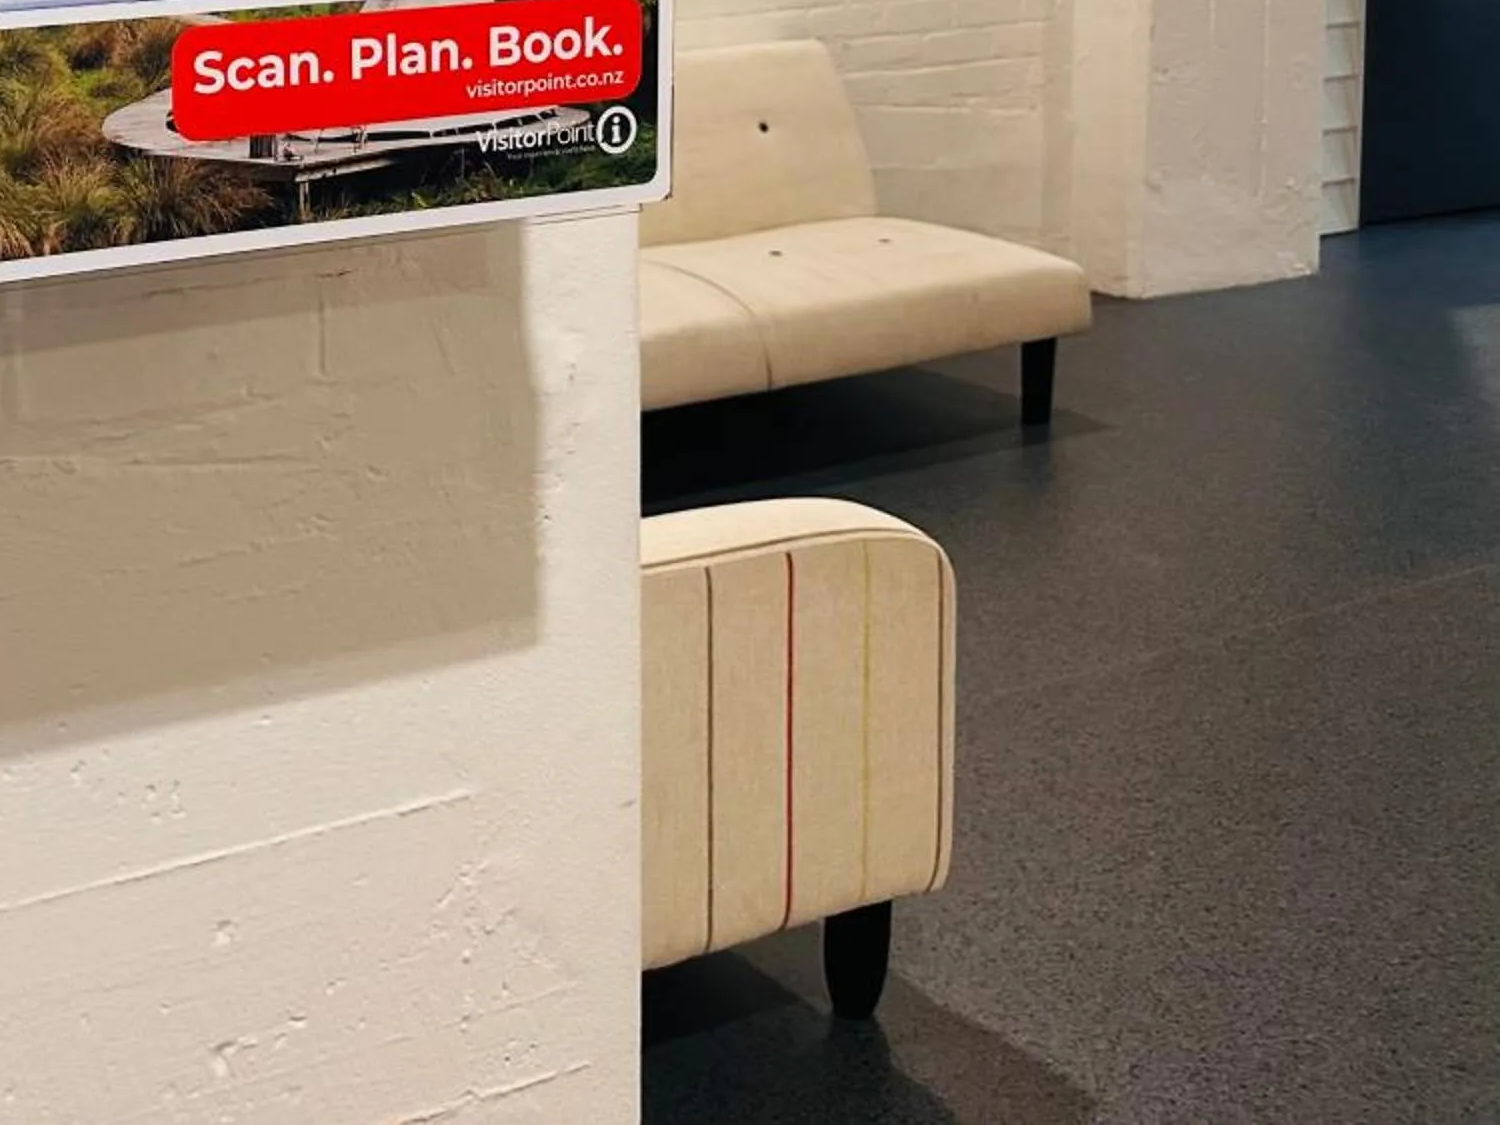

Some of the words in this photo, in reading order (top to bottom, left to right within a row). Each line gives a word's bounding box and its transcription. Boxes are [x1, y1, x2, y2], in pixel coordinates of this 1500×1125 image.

[194, 50, 333, 94] Scan.
[351, 34, 473, 79] Plan.
[489, 17, 623, 67] Book.
[466, 70, 624, 99] visitorpoint.co.nz
[476, 121, 595, 153] VisitorPoint
